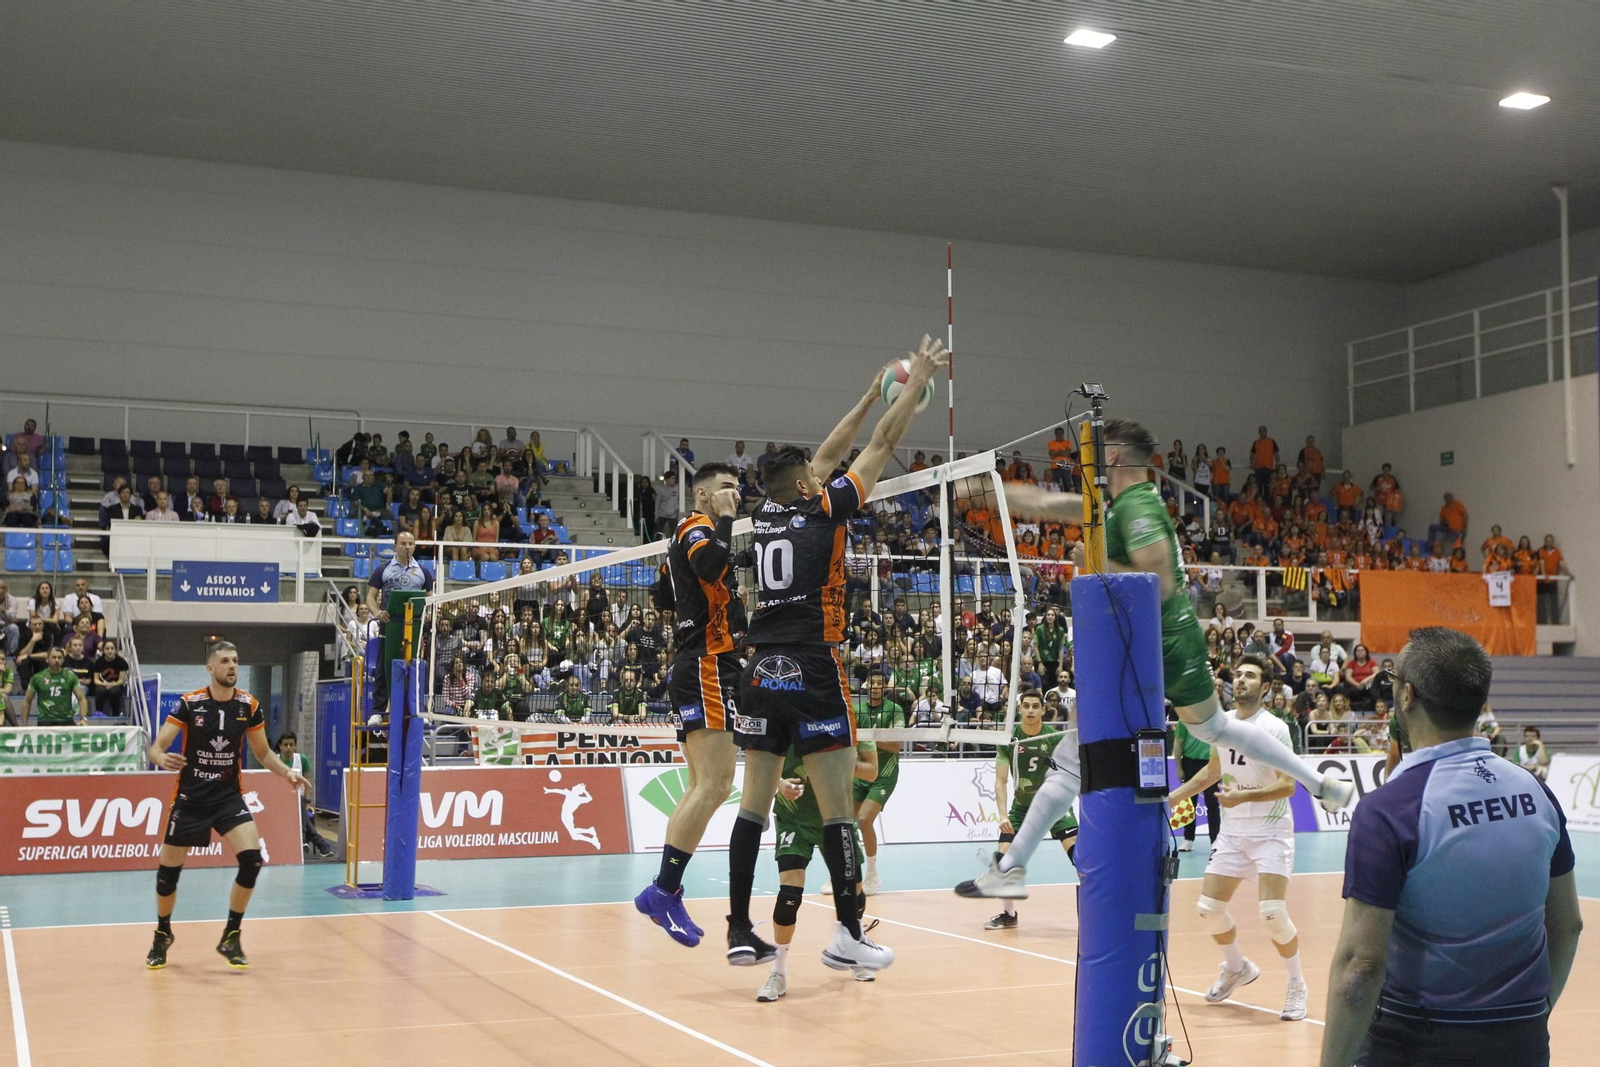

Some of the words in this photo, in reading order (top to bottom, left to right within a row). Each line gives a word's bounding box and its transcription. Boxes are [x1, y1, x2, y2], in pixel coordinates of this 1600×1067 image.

[755, 540, 794, 591] 10
[206, 575, 236, 585] ASEOS
[240, 576, 246, 585] Y
[1496, 582, 1503, 592] 4
[196, 586, 255, 597] VESTUARIOS
[49, 686, 61, 697] 15
[760, 678, 805, 691] RONAL
[727, 699, 738, 719] 9
[218, 709, 225, 731] 1
[0, 732, 126, 755] CAMPEON
[1027, 757, 1039, 773] 5
[22, 797, 163, 839] SVM
[419, 790, 504, 829] VM
[1447, 792, 1538, 829] RFEVB
[168, 821, 176, 836] 1
[445, 832, 496, 848] VOLEIBOL
[497, 831, 559, 846] MASCULINA
[780, 831, 796, 845] 14
[17, 845, 88, 861] SUPERLIGA
[91, 843, 150, 859] VOLEIBOL
